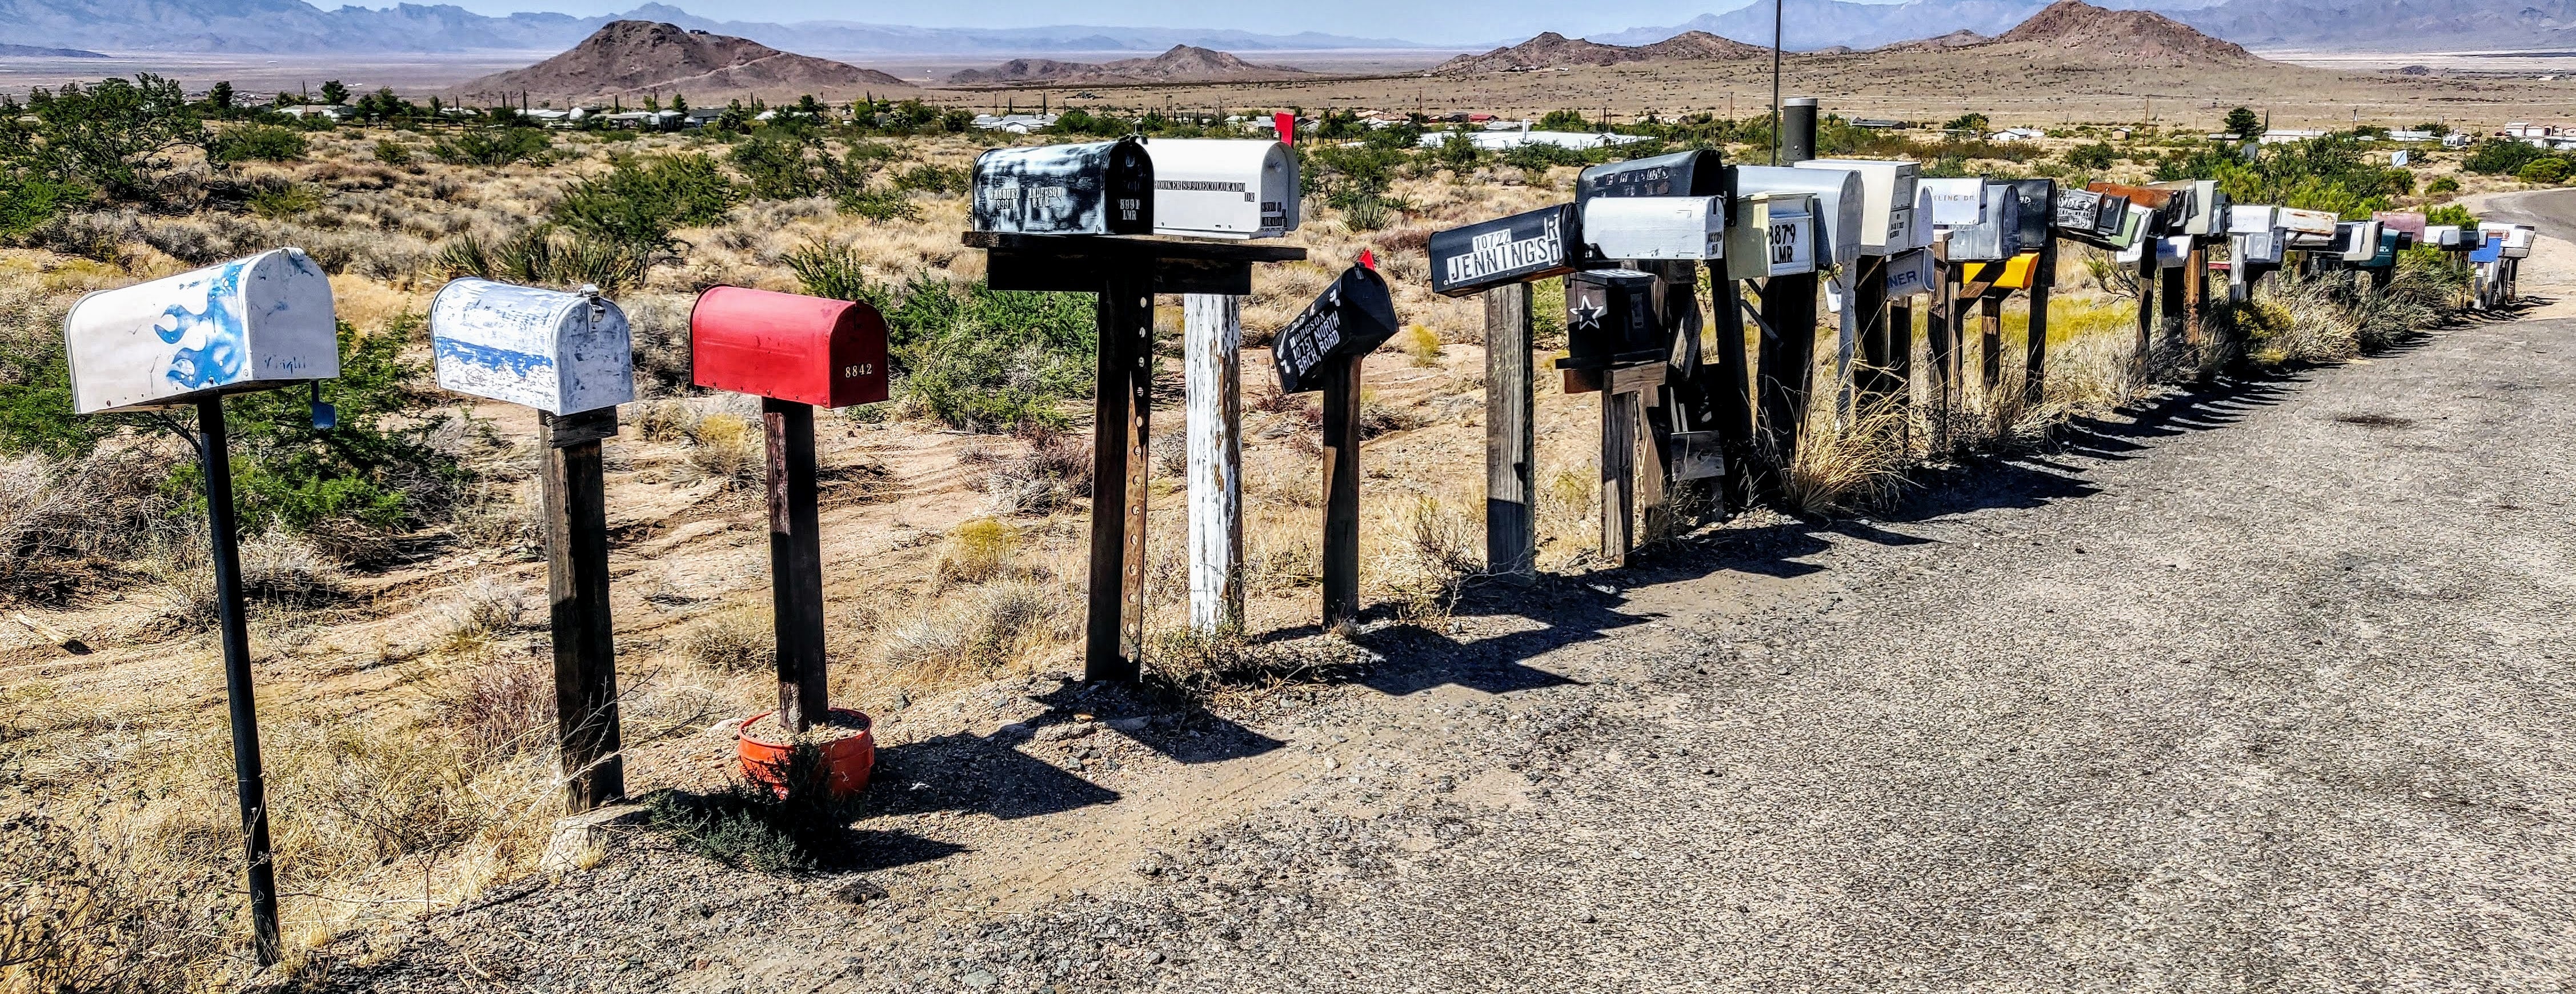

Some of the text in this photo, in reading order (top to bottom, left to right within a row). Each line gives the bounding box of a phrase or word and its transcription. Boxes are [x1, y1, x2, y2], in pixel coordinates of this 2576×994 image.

[989, 187, 1062, 199] VASQUEZ ANDERSON
[1207, 182, 1245, 192] COLORADO
[996, 199, 1013, 210] 8991
[1120, 199, 1140, 210] 8991
[1122, 209, 1137, 221] LMR
[1475, 230, 1511, 251] 10722
[1769, 223, 1796, 245] 8879
[1451, 238, 1547, 280] JENNINGS
[1772, 245, 1793, 264] LMR
[1289, 311, 1325, 349] HODGSON
[1292, 335, 1314, 360] 10751
[1314, 310, 1340, 343] NORTH
[1318, 330, 1340, 356] ROAD
[846, 363, 872, 378] 8842
